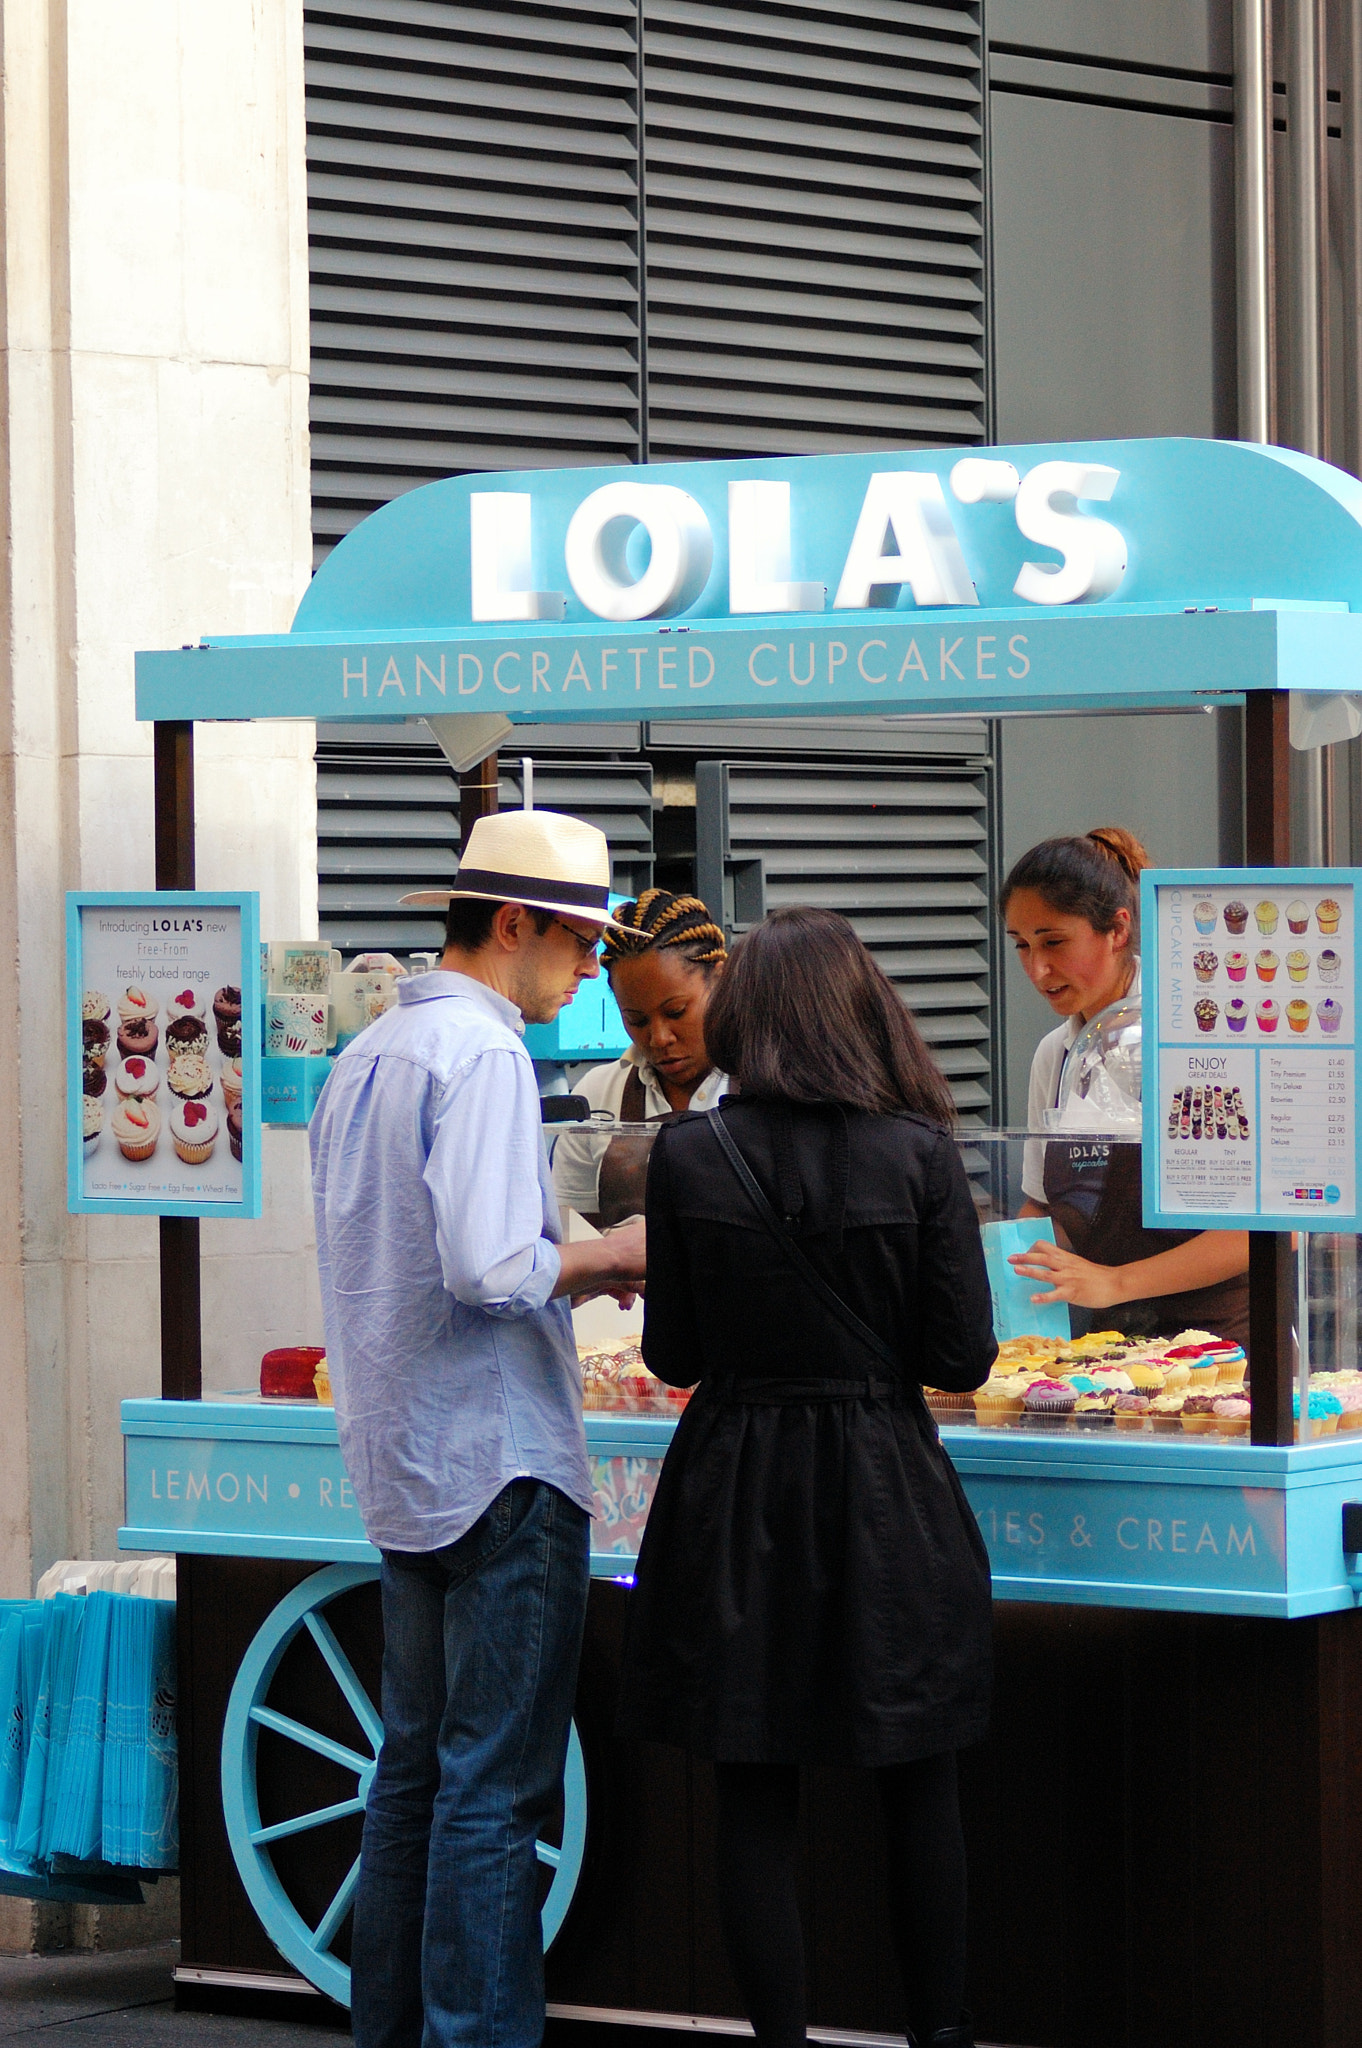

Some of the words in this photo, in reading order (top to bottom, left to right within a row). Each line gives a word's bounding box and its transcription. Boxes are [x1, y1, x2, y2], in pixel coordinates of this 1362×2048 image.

[470, 457, 1128, 622] LOLA'S
[341, 645, 716, 698] HANDCRAFTED
[748, 633, 1032, 687] CUPCAKES
[99, 920, 150, 935] Introducing
[152, 919, 203, 932] LOLA'S
[206, 923, 227, 932] new
[1170, 889, 1183, 969] CUPCAKE
[137, 942, 189, 955] Free-From
[116, 965, 146, 981] freshly
[149, 966, 179, 979] baked
[182, 969, 210, 982] range
[1170, 978, 1183, 1030] MENU
[1188, 1057, 1227, 1070] ENJOY
[1270, 1058, 1281, 1066] Tiny
[1188, 1071, 1207, 1079] GREAT
[1209, 1071, 1228, 1079] DEALS
[1270, 1070, 1281, 1078] Tiny
[1270, 1082, 1281, 1091] Tiny
[1271, 1113, 1292, 1122] Regular
[109, 1181, 122, 1190] Free
[129, 1182, 146, 1193] Sugar
[168, 1183, 180, 1194] Egg
[202, 1184, 223, 1193] Wheat
[225, 1184, 238, 1194] Free
[151, 1468, 268, 1504] LEMON
[318, 1476, 354, 1509] RE
[1069, 1514, 1093, 1548] &
[1116, 1516, 1257, 1557] CREAM
